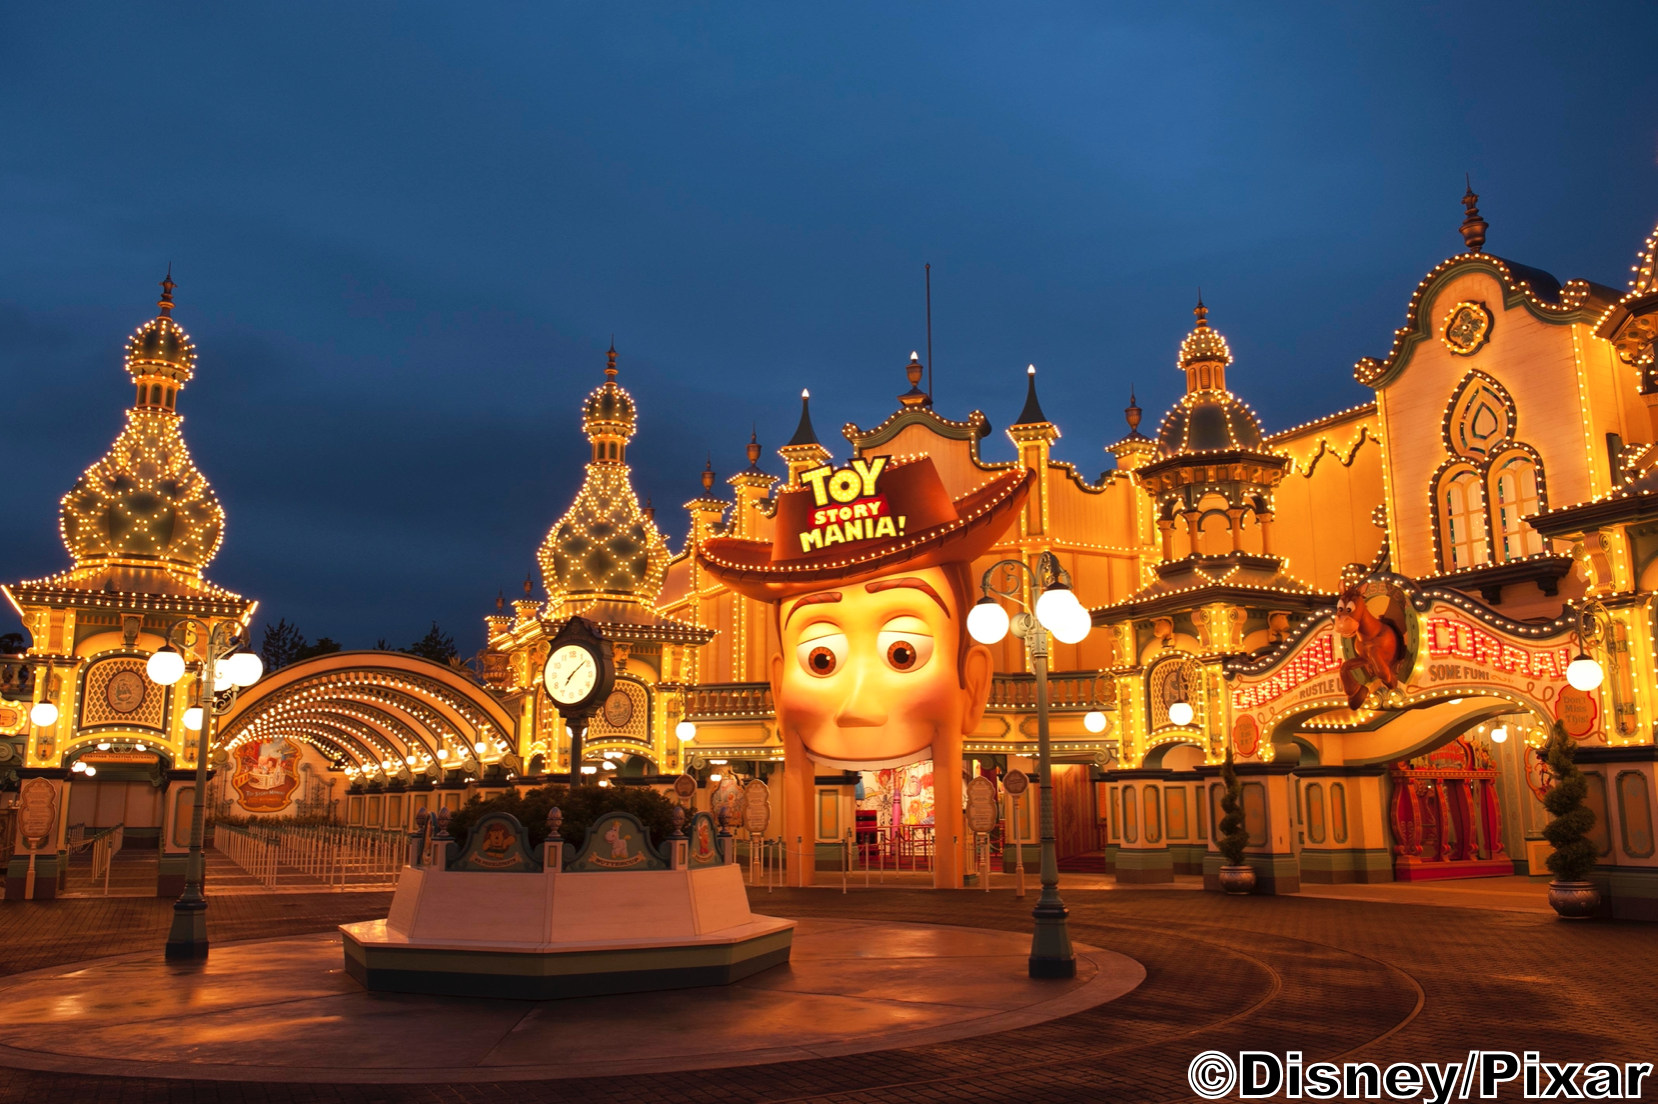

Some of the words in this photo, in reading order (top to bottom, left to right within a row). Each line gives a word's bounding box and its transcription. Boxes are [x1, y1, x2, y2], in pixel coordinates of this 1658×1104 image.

[800, 457, 889, 508] TOY
[814, 501, 881, 525] STORY
[799, 515, 906, 553] MANIA!
[568, 650, 577, 658] 12
[1231, 634, 1342, 709] CARNIVAL
[1300, 678, 1335, 699] RUSTLE
[1429, 664, 1461, 681] SOME
[1463, 666, 1489, 680] FUN!
[1564, 705, 1587, 713] Miss
